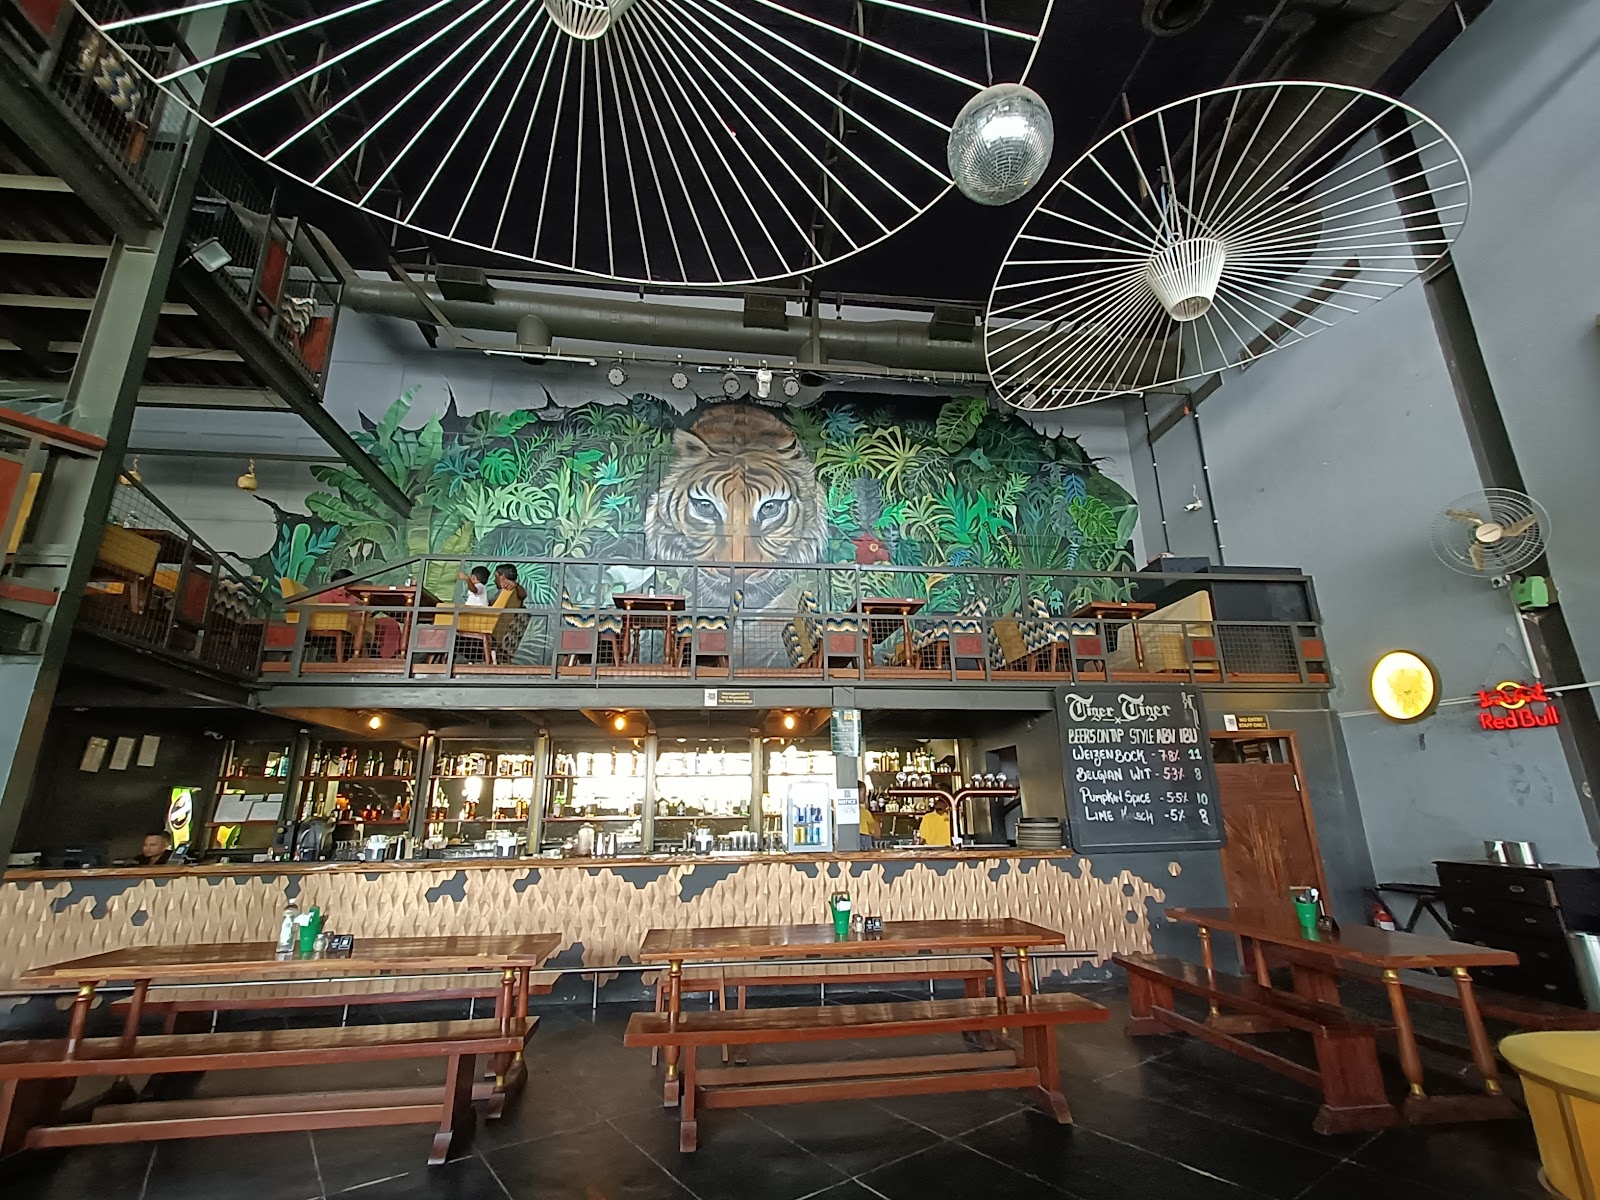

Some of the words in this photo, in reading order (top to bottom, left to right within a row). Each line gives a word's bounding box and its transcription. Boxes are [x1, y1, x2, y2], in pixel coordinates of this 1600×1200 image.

[1064, 693, 1114, 722] Tiger
[1118, 693, 1171, 722] Tiger
[1480, 710, 1518, 729] Red
[1519, 706, 1559, 727] Bull
[1068, 728, 1096, 744] BEERS
[1097, 728, 1109, 744] ON
[1109, 728, 1124, 743] TAP
[1129, 728, 1154, 744] STYLE
[1156, 728, 1176, 744] ABV
[1179, 728, 1198, 744] IBU
[1188, 748, 1202, 760] 11
[1076, 767, 1123, 784] BELGIAN
[1130, 766, 1152, 780] WIT
[1194, 768, 1202, 780] 8
[1197, 792, 1208, 805] 10
[1084, 806, 1114, 821] LIME
[1199, 808, 1211, 826] 8
